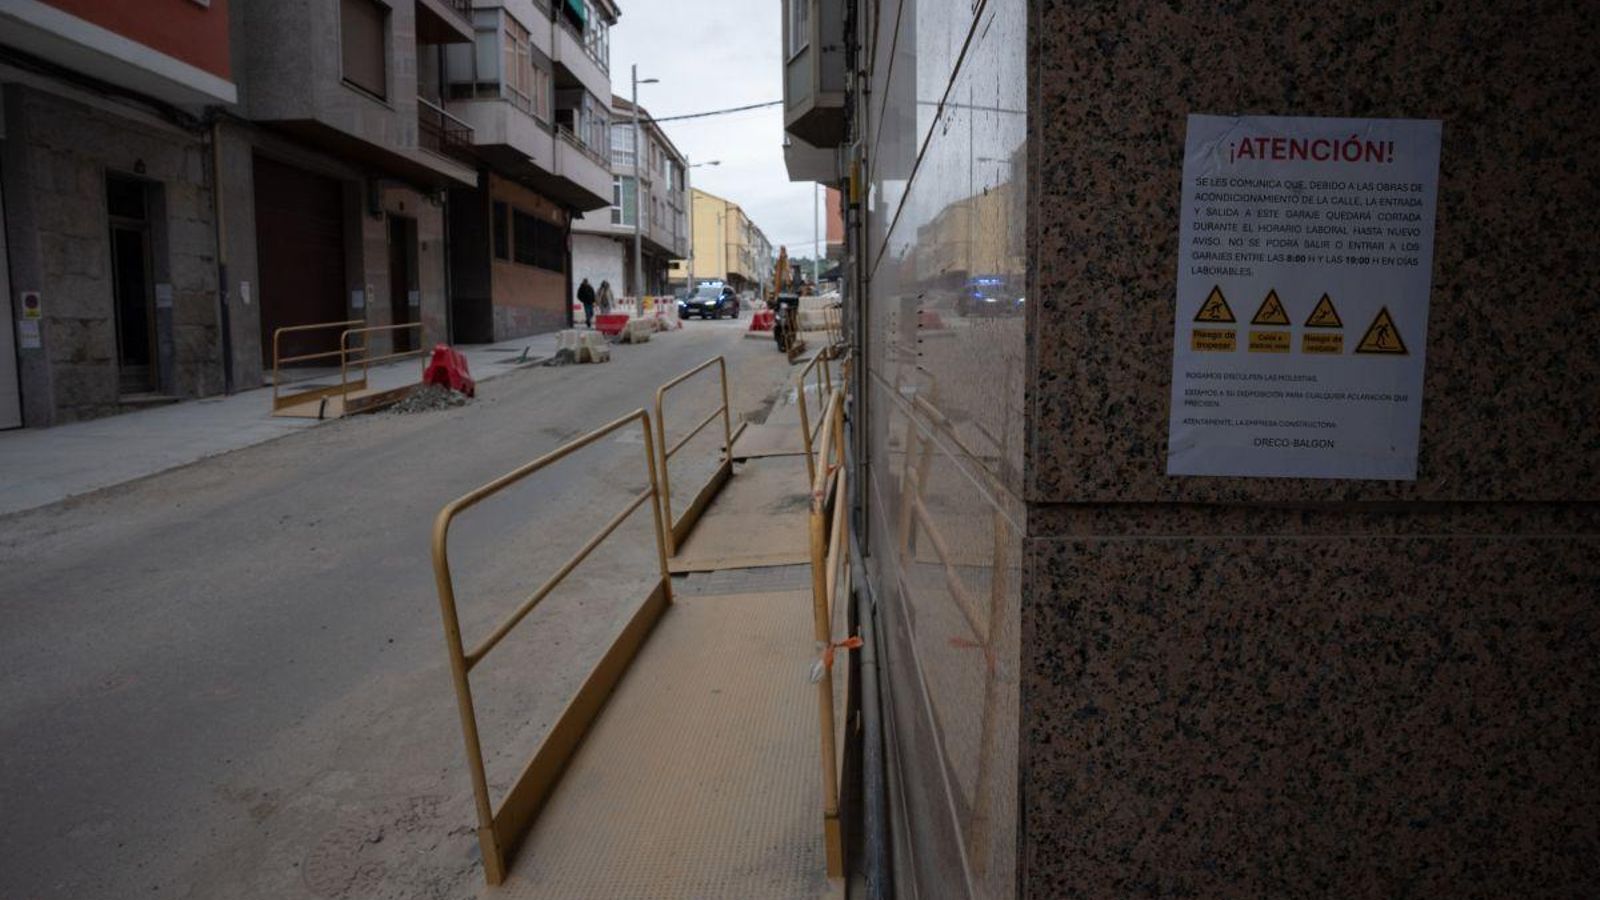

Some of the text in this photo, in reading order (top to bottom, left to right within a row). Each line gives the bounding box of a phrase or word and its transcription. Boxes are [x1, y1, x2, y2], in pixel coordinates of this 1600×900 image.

[1230, 135, 1394, 165] ¡ATENCIÓN!
[1195, 177, 1208, 186] SE
[1210, 178, 1228, 187] LES
[1230, 178, 1282, 189] COMUNICA
[1310, 181, 1346, 190] DEBIDO
[1348, 182, 1354, 190] A
[1357, 183, 1374, 191] LAS
[1376, 183, 1408, 192] OBRAS
[1411, 184, 1423, 192] DE
[1195, 193, 1300, 204] ACONDICIONAMIENTO
[1302, 196, 1314, 204] DE
[1317, 196, 1328, 204] LA
[1380, 198, 1423, 206] ENTRADA
[1206, 208, 1239, 217] SALIDA
[1244, 209, 1252, 217] A
[1257, 209, 1279, 218] ESTE
[1286, 211, 1320, 219] GARAJE
[1378, 213, 1422, 221] CORTADA
[1193, 222, 1421, 236] DURANTE EL HORARIO LABORAL HASTA NUEVO
[1229, 238, 1243, 246] NO
[1248, 239, 1261, 247] SE
[1304, 240, 1330, 249] SALIR
[1335, 241, 1343, 249] O
[1349, 241, 1384, 250] ENTRAR
[1401, 242, 1420, 251] LOS
[1192, 251, 1232, 261] GARAJES
[1235, 253, 1265, 262] ENTRE
[1268, 254, 1284, 262] LAS
[1308, 255, 1315, 263] H
[1318, 255, 1324, 263] Y
[1382, 257, 1394, 265] EN
